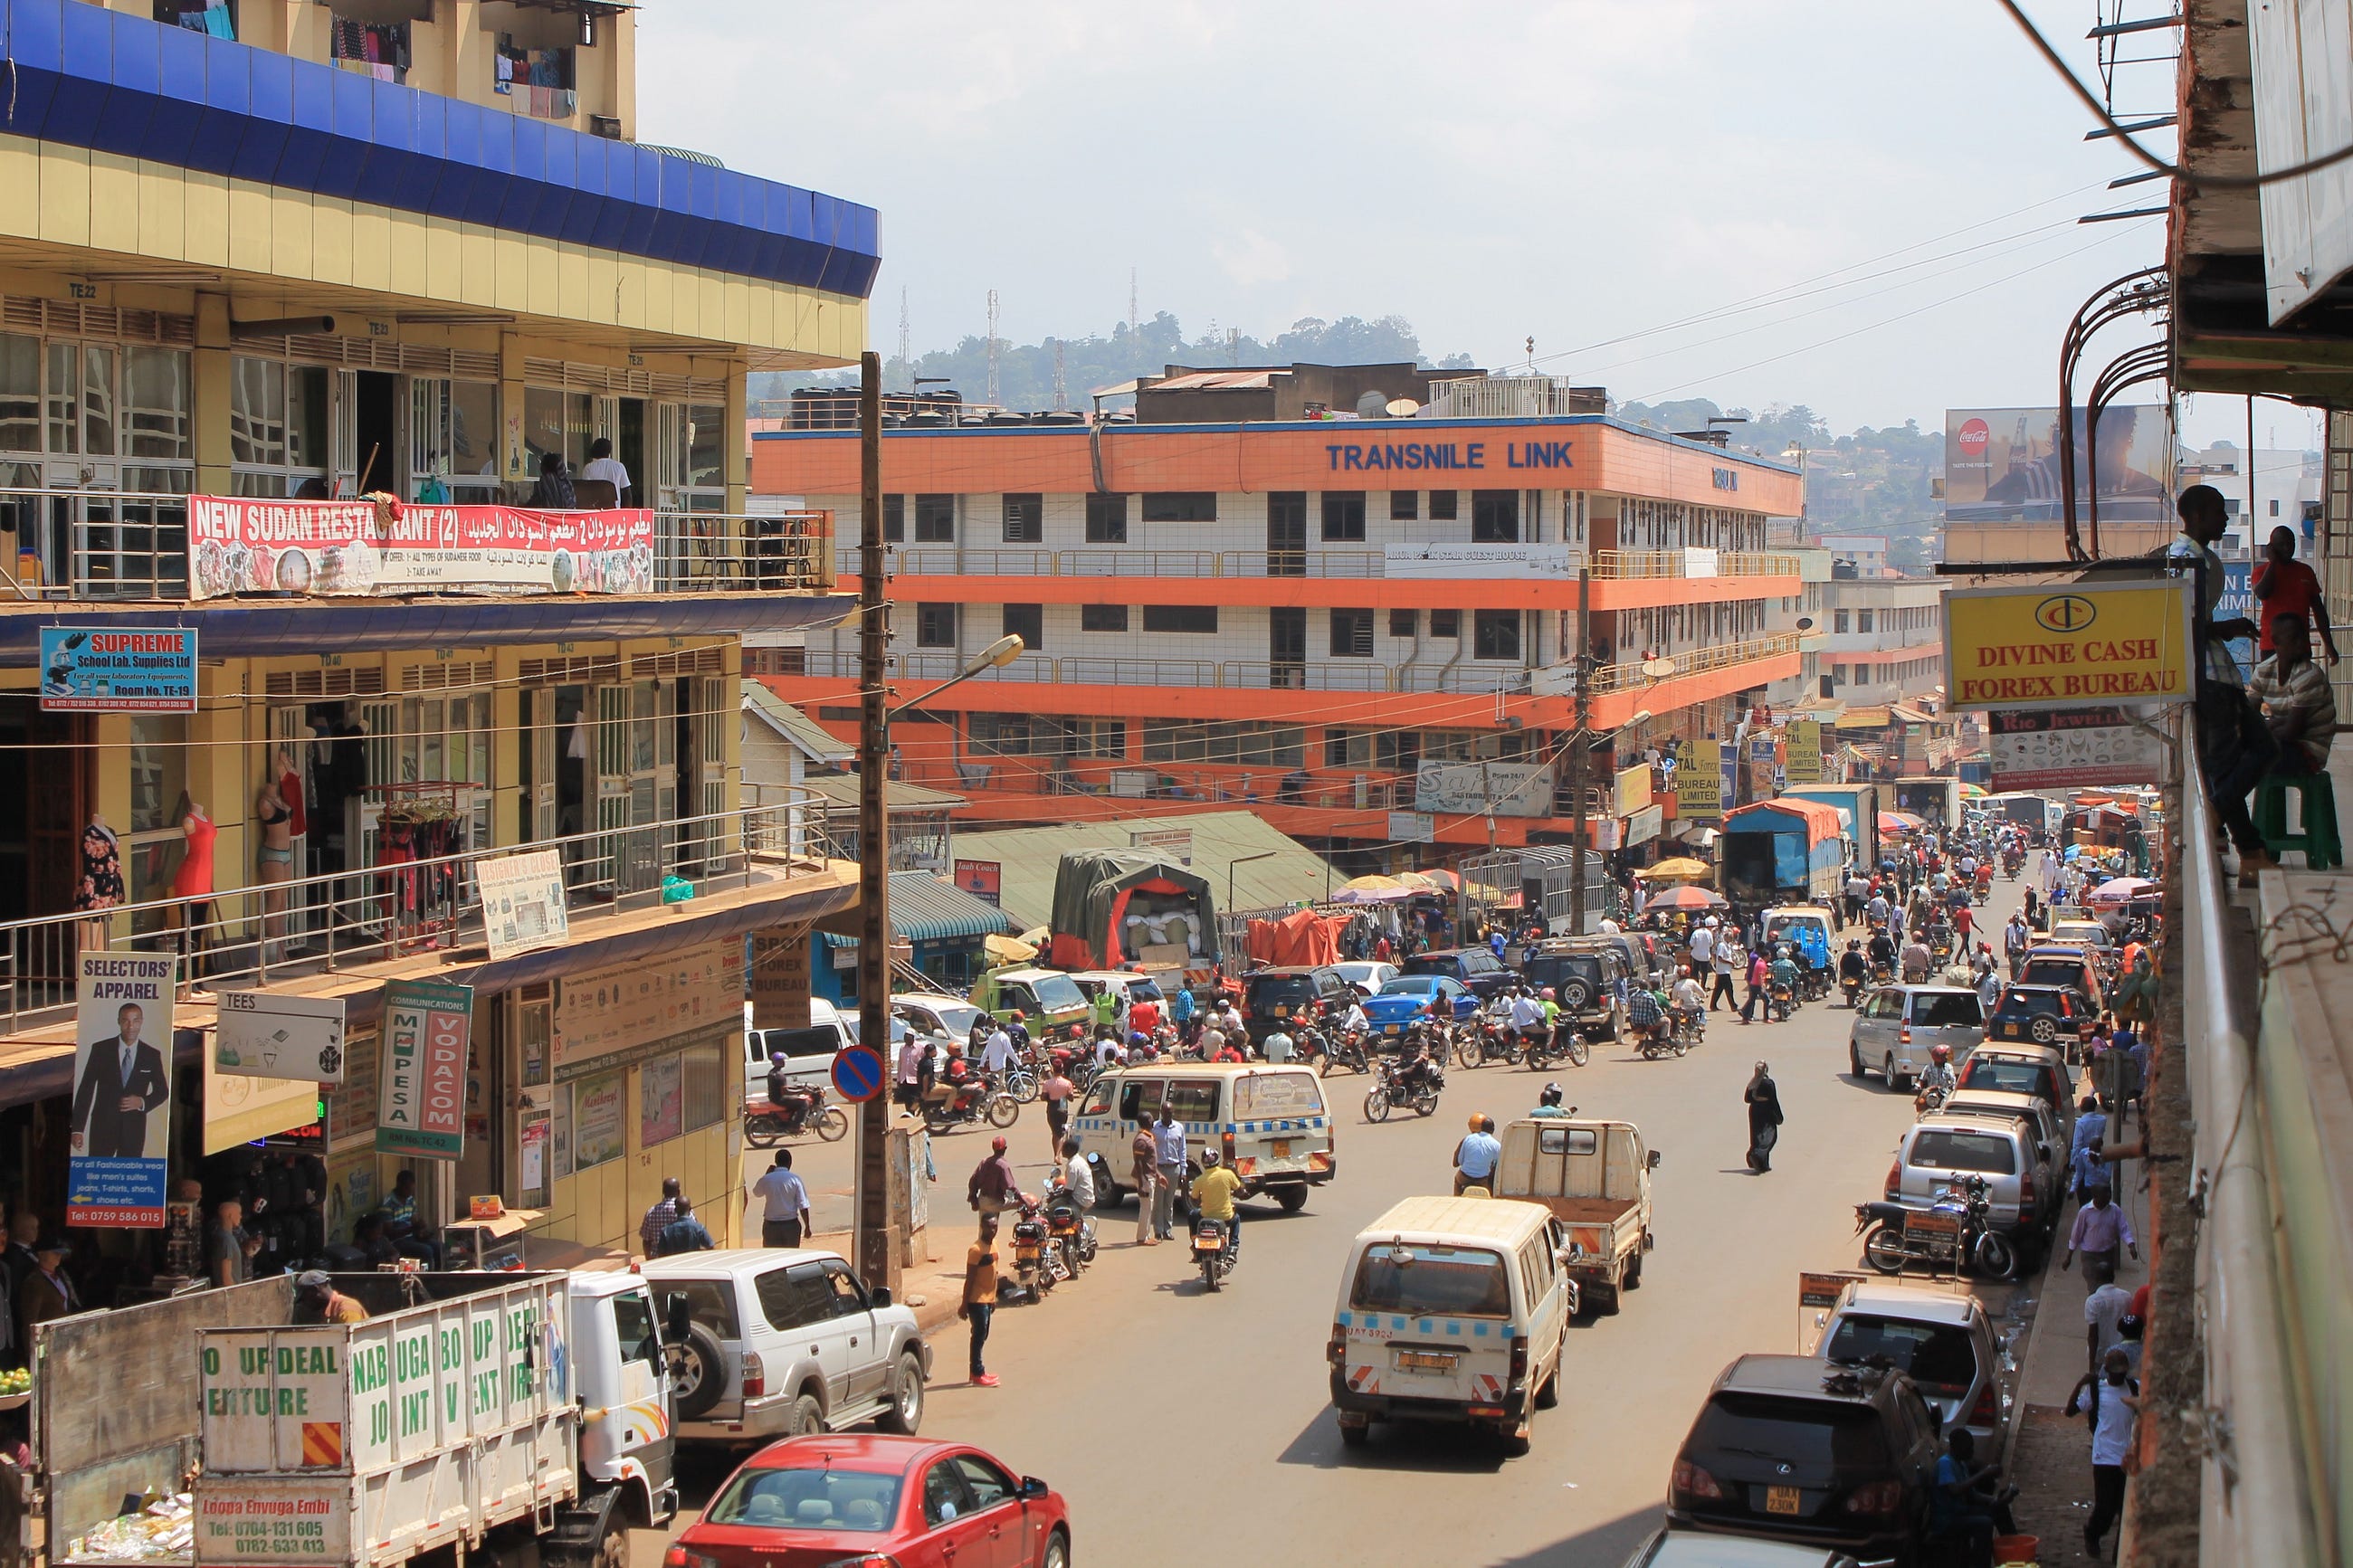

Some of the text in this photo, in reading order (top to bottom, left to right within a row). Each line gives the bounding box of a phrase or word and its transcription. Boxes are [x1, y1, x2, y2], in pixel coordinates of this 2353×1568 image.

[1326, 442, 1573, 470] TRANSNILE LINK
[196, 500, 242, 540] NEW
[247, 505, 316, 542] SUDAN
[439, 508, 459, 549] (2)
[1439, 550, 1462, 560] STAR
[1462, 551, 1493, 560] GUEST
[1495, 551, 1527, 560] HOUSE
[413, 567, 425, 577] TAKE
[426, 567, 442, 577] AWAY
[91, 634, 184, 653] SUPREME
[1977, 639, 2158, 667] DIVINE CASH
[78, 655, 190, 670] School Lab. Supplies Ltd
[111, 672, 146, 680] laboratory
[115, 685, 189, 697] Room No. TE-19
[1960, 670, 2177, 700] FOREX BUREAU
[1786, 734, 1801, 745] TAL
[1786, 750, 1820, 758] BUREAU
[1677, 758, 1719, 774] TAL Forex
[1789, 759, 1817, 767] LIMITED
[1678, 780, 1720, 789] BUREAU
[1682, 791, 1717, 801] LIMITED
[479, 852, 559, 882] DESIGNER'S CLOSET
[976, 864, 998, 873] Coach
[756, 937, 805, 952] SPOT
[84, 960, 172, 978] SELECTORS'
[760, 959, 802, 972] FOREX
[93, 982, 159, 1000] APPAREL
[756, 979, 807, 993] BUREAU
[226, 993, 255, 1010] TEES
[390, 996, 464, 1011] COMMUNICATIONS
[428, 1018, 458, 1126] VODACOM
[434, 1137, 446, 1147] 42
[97, 1161, 143, 1169] Fashionable
[77, 1184, 156, 1194] jeans, T-shirts, shorts,
[71, 1212, 160, 1222] Tel: 0759 586 015
[204, 1498, 329, 1516] Loopa Envuga Embi
[209, 1522, 322, 1536] Tel: 0704-131 605
[236, 1539, 325, 1554] 0782-633 413
